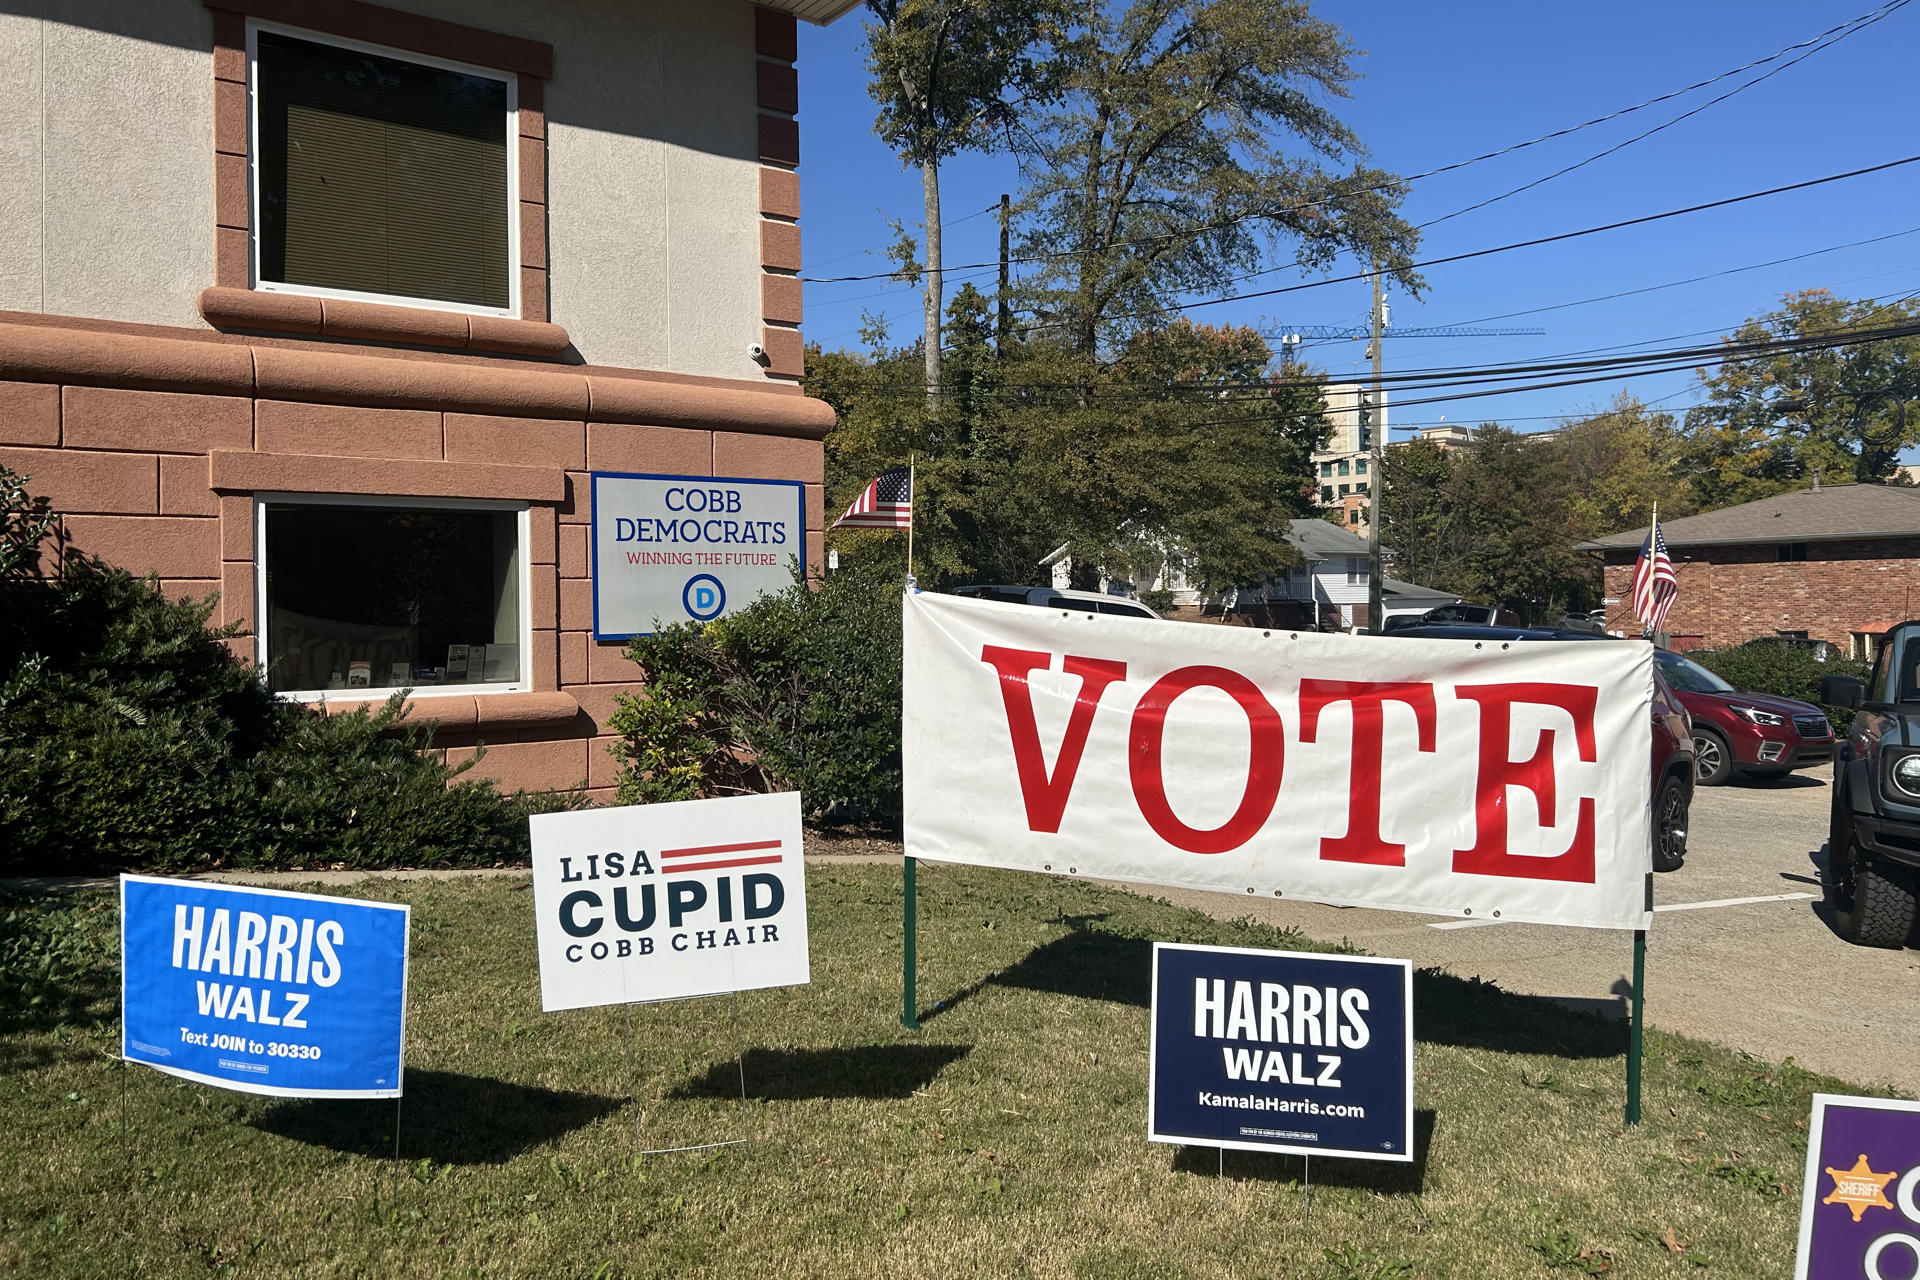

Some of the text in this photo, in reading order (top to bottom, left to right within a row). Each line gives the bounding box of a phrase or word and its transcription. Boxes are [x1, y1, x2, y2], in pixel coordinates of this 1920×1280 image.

[665, 487, 742, 513] COBB
[615, 517, 786, 544] DEMOCRATS
[626, 551, 777, 566] WINNING THE FUTURE
[696, 587, 715, 609] D
[981, 644, 1599, 884] VOTE
[560, 850, 654, 883] LISA
[558, 872, 785, 938] CUPID
[172, 904, 344, 988] HARRIS
[565, 924, 779, 963] COBB CHAIR
[196, 980, 310, 1029] WALZ
[1194, 977, 1371, 1050] HARRIS
[180, 1026, 321, 1060] Text JOIN to 30330
[1222, 1047, 1342, 1088] WALZ
[1199, 1091, 1365, 1119] KamalaHarris.com
[1838, 1181, 1881, 1197] SHERIFF
